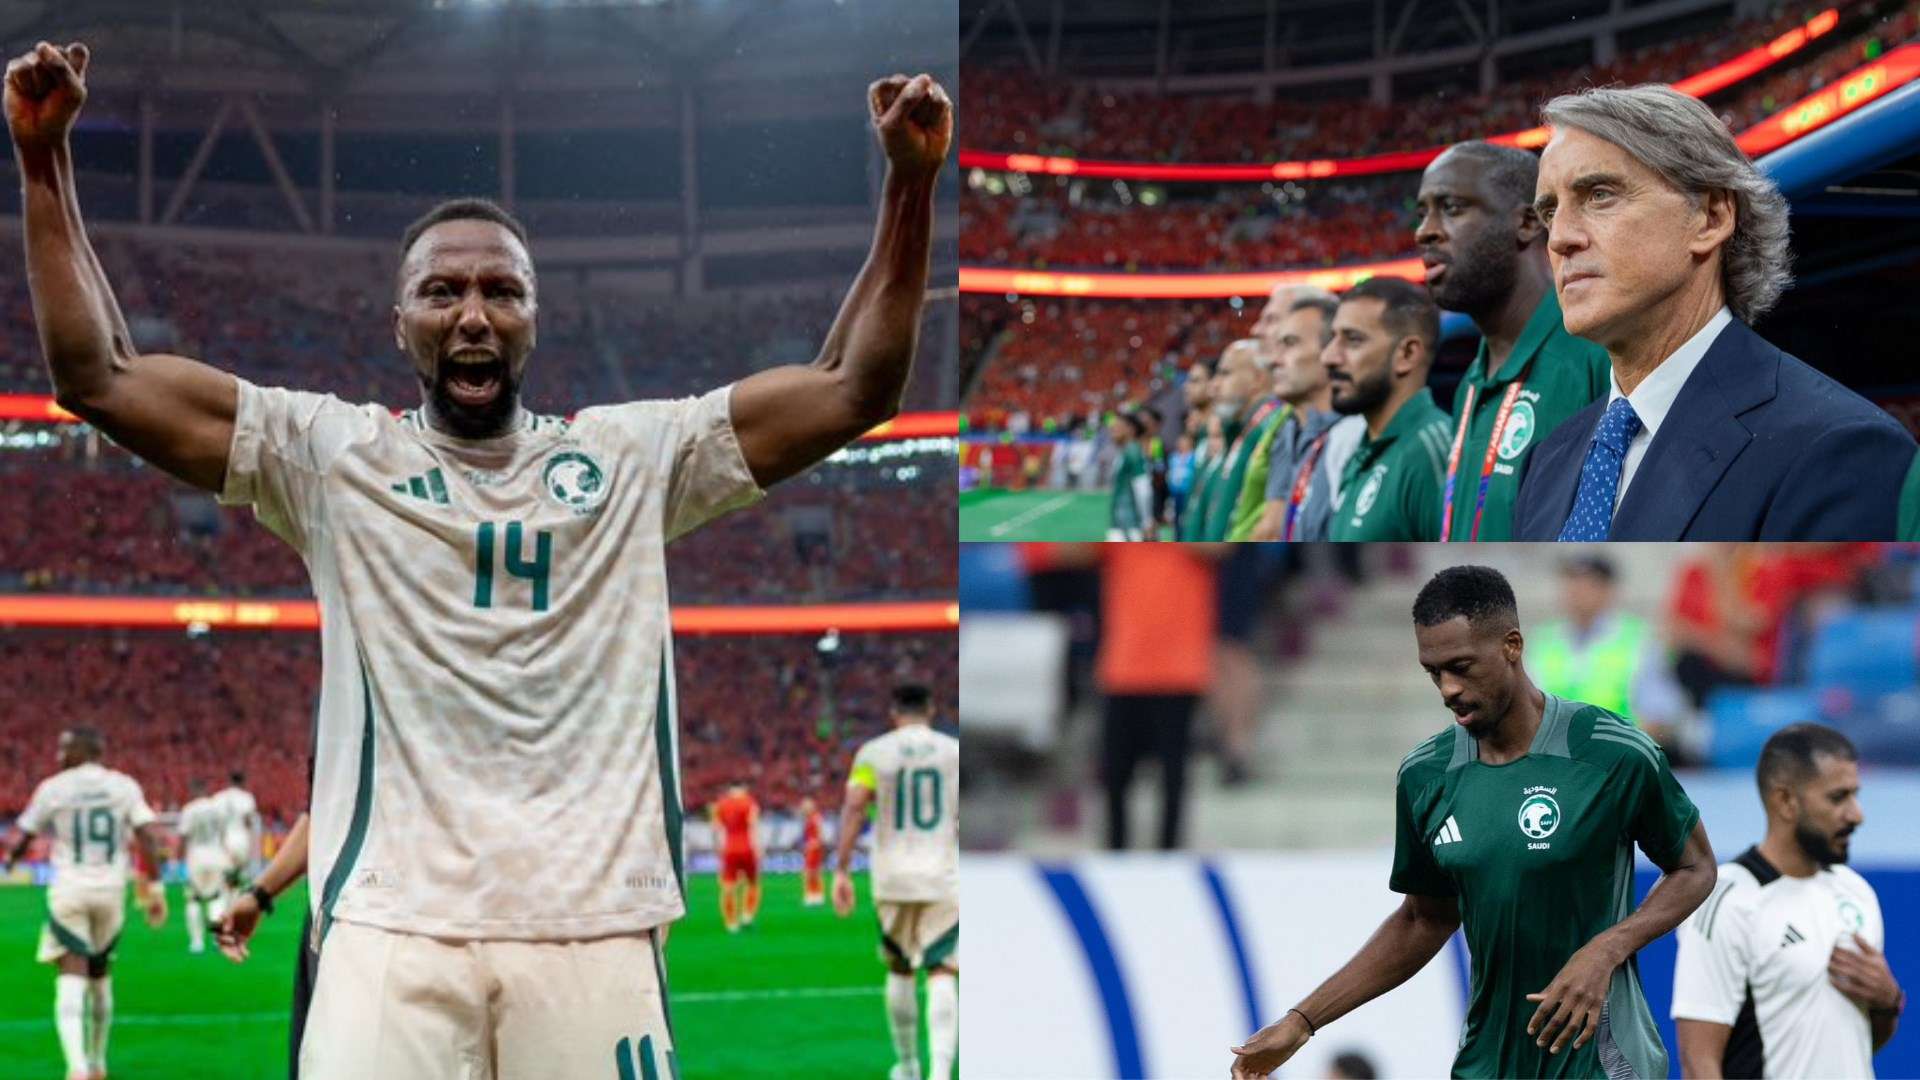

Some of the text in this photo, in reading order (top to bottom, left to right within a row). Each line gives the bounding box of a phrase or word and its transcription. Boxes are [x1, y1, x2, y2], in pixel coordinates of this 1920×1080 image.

[473, 520, 552, 612] 14
[895, 766, 942, 831] 10
[74, 806, 116, 864] 19
[1528, 842, 1550, 850] SAUDI
